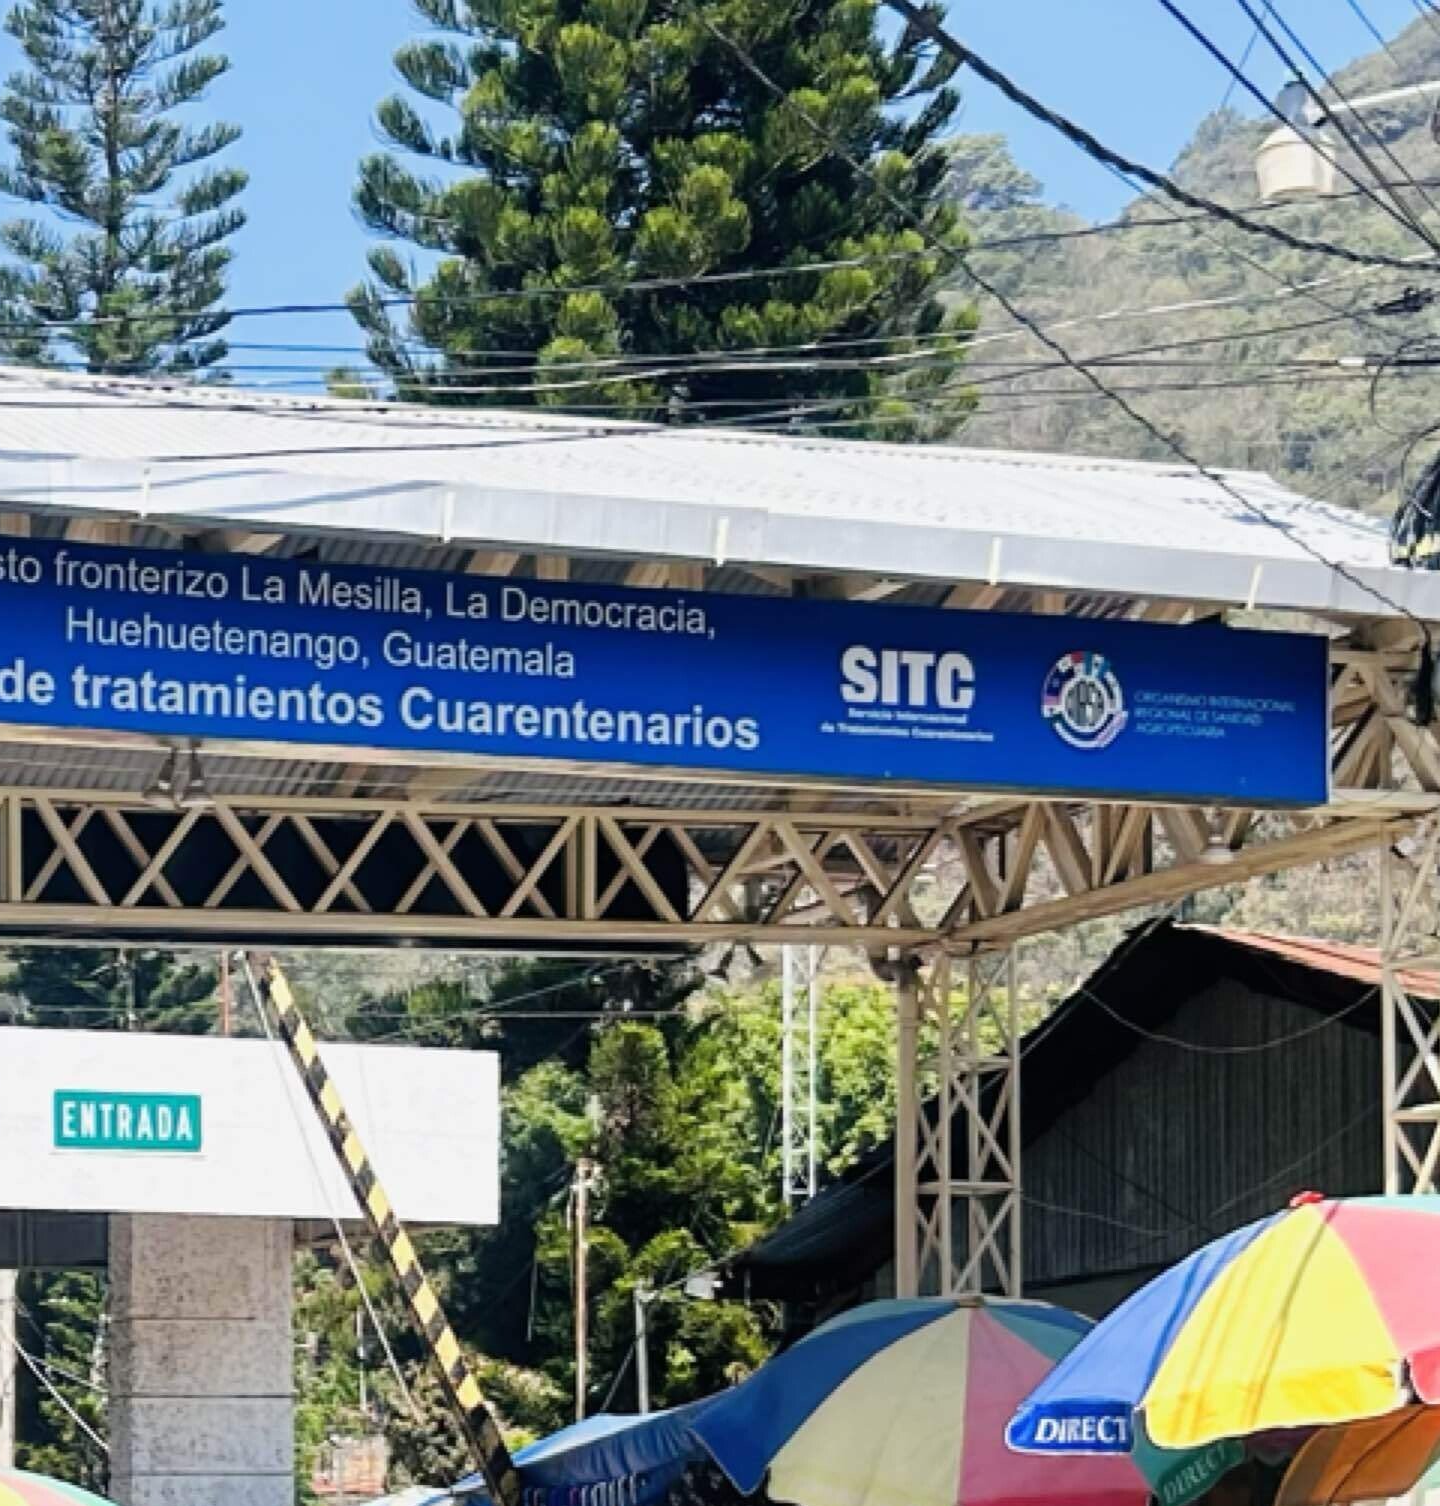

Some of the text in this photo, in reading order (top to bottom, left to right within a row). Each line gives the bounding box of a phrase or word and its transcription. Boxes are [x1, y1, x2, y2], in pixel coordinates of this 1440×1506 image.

[55, 549, 228, 599] fronterizo
[242, 566, 284, 603] La
[298, 569, 432, 619] Mesilla,
[446, 583, 487, 619] La
[501, 588, 716, 639] Democracia,
[66, 606, 576, 678] Huehuetenango, Guatemala
[71, 659, 385, 728] tratamientos
[400, 685, 761, 751] Cuarentenarios
[840, 645, 976, 709] SITC
[61, 1100, 194, 1142] ENTRADA
[1034, 1415, 1128, 1443] DIRECT
